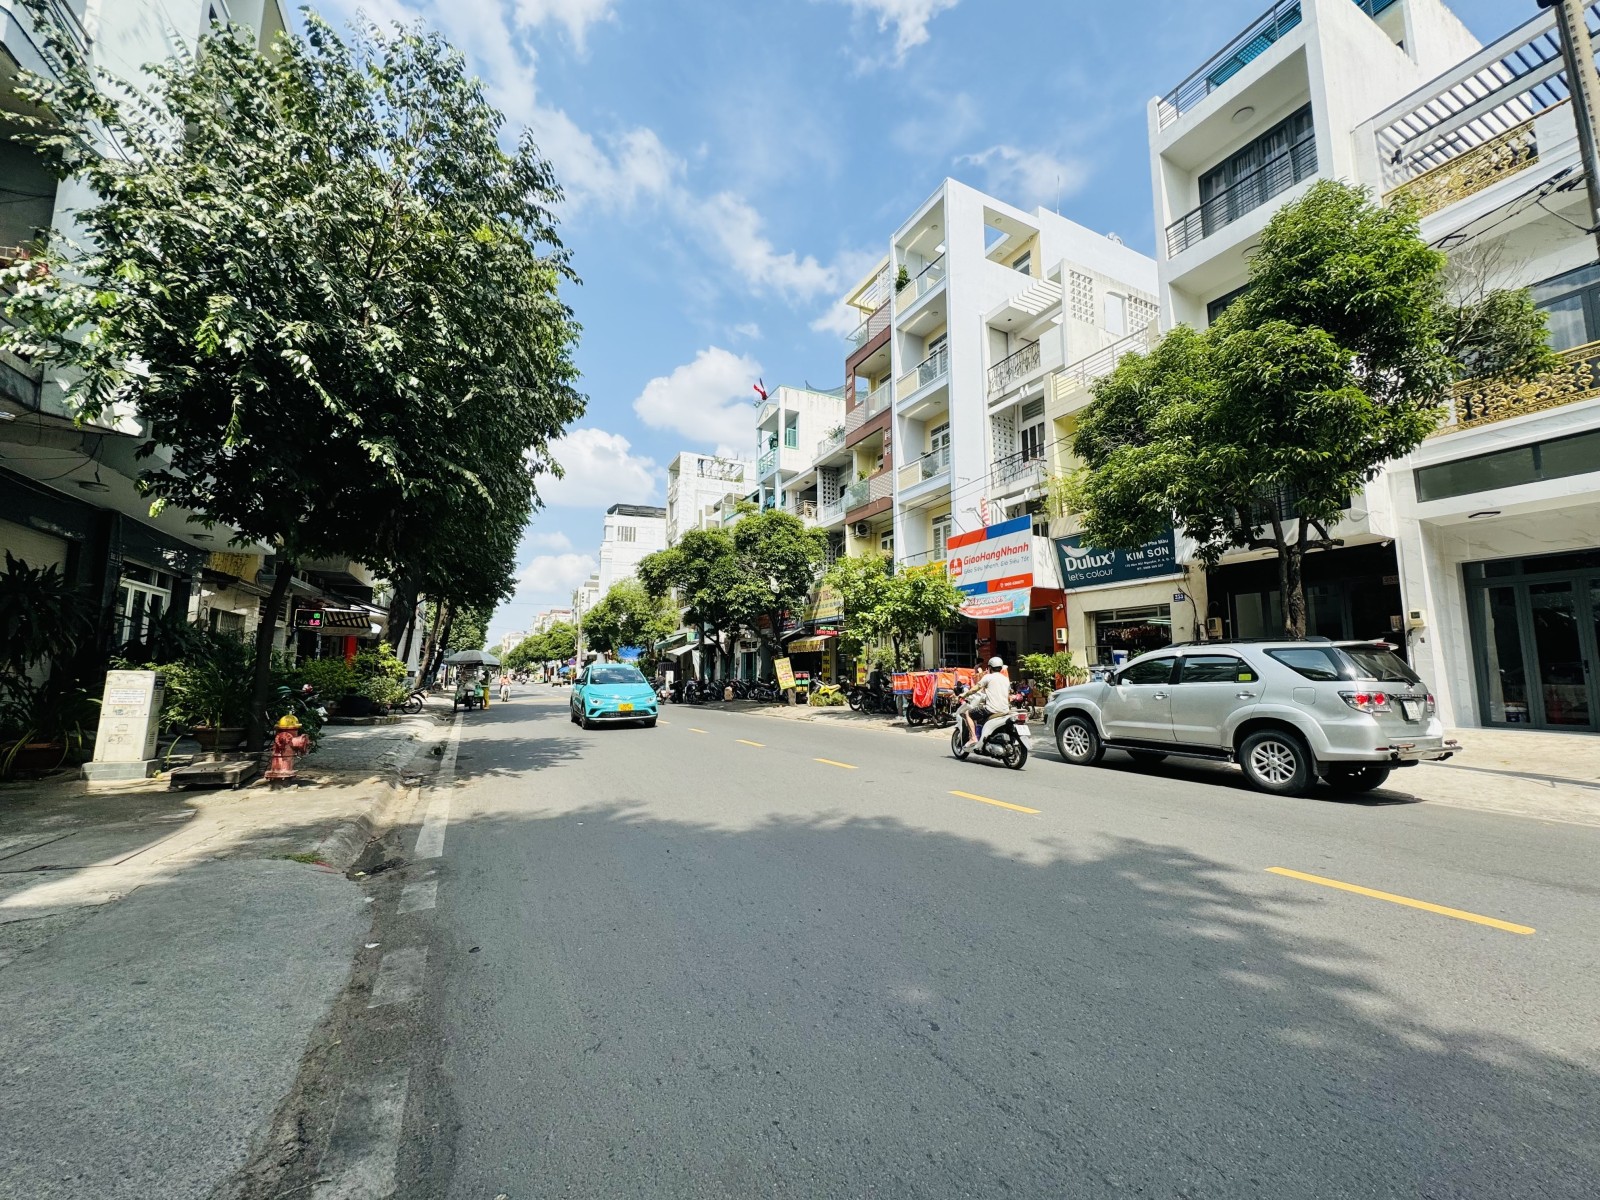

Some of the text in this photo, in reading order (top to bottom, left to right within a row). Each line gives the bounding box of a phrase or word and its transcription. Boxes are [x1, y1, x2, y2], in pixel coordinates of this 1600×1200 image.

[963, 541, 1029, 565] GiaoHangNhanh
[1125, 546, 1170, 561] KIM SƠN
[1064, 553, 1111, 571] Dulux
[1067, 568, 1114, 582] let's colour
